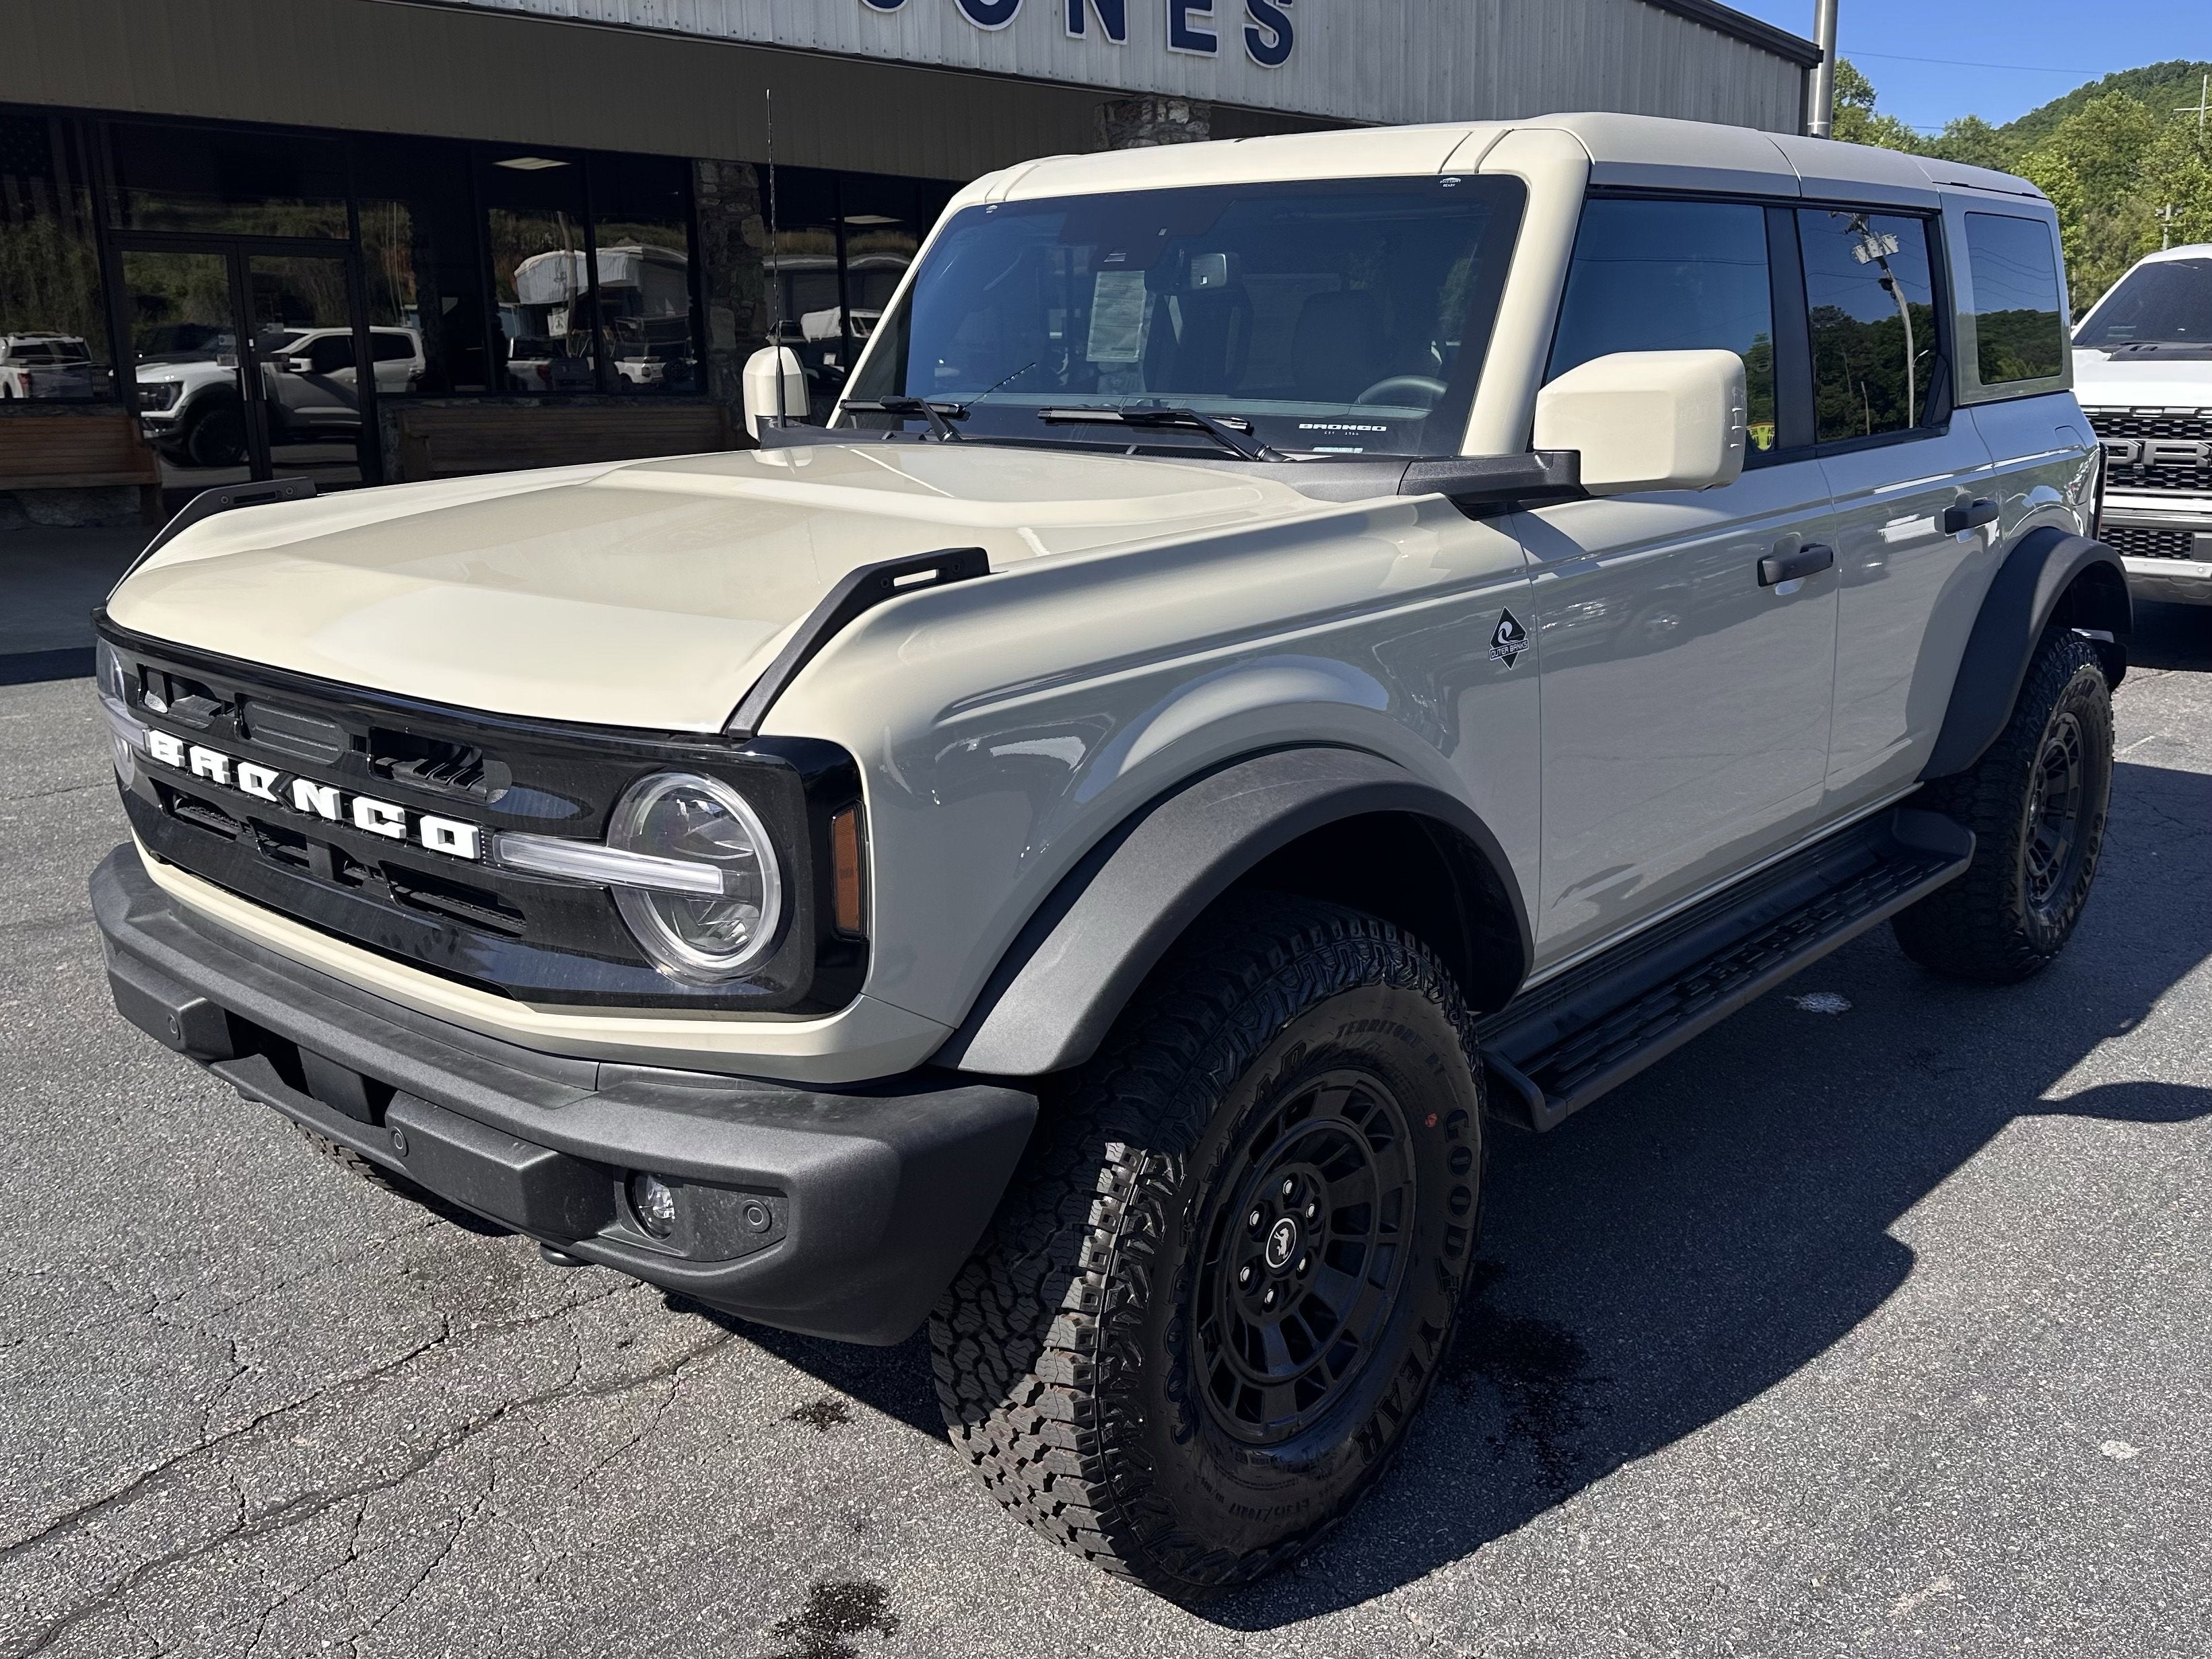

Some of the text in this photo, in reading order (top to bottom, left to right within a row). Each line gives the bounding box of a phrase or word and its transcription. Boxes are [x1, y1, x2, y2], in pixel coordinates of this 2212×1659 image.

[1299, 423, 1387, 431] BRONCO
[1491, 641, 1527, 658] OUTER BANKS
[149, 729, 483, 859] BRONCO
